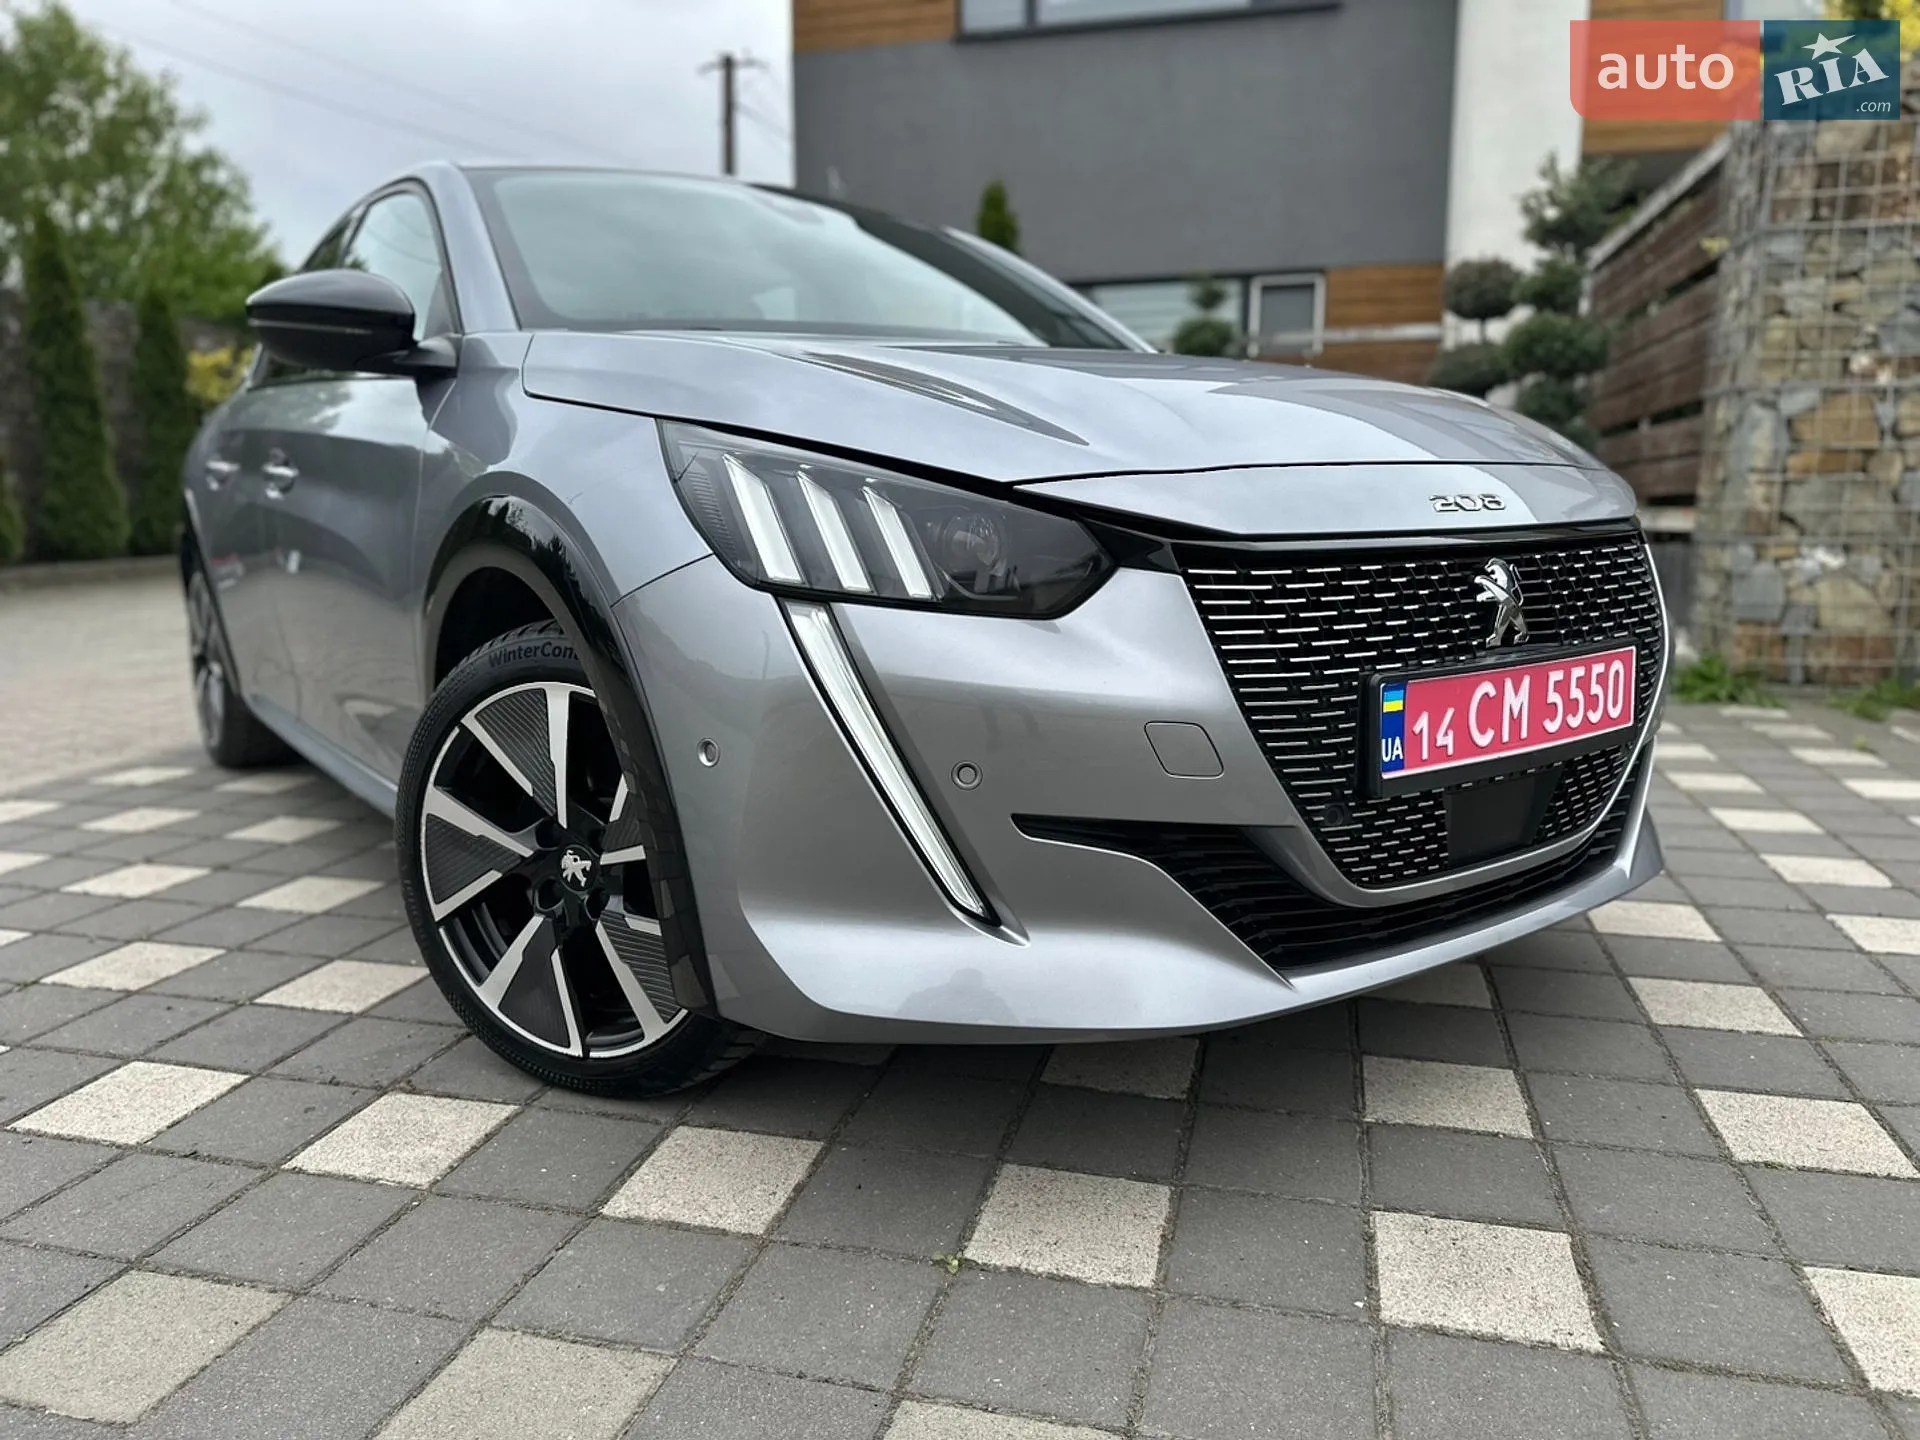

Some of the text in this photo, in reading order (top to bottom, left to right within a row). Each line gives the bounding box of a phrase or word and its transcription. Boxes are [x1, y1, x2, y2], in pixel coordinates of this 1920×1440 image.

[1429, 493, 1507, 513] 208
[1412, 659, 1625, 761] 14 CM 5550
[1382, 737, 1404, 762] UA
